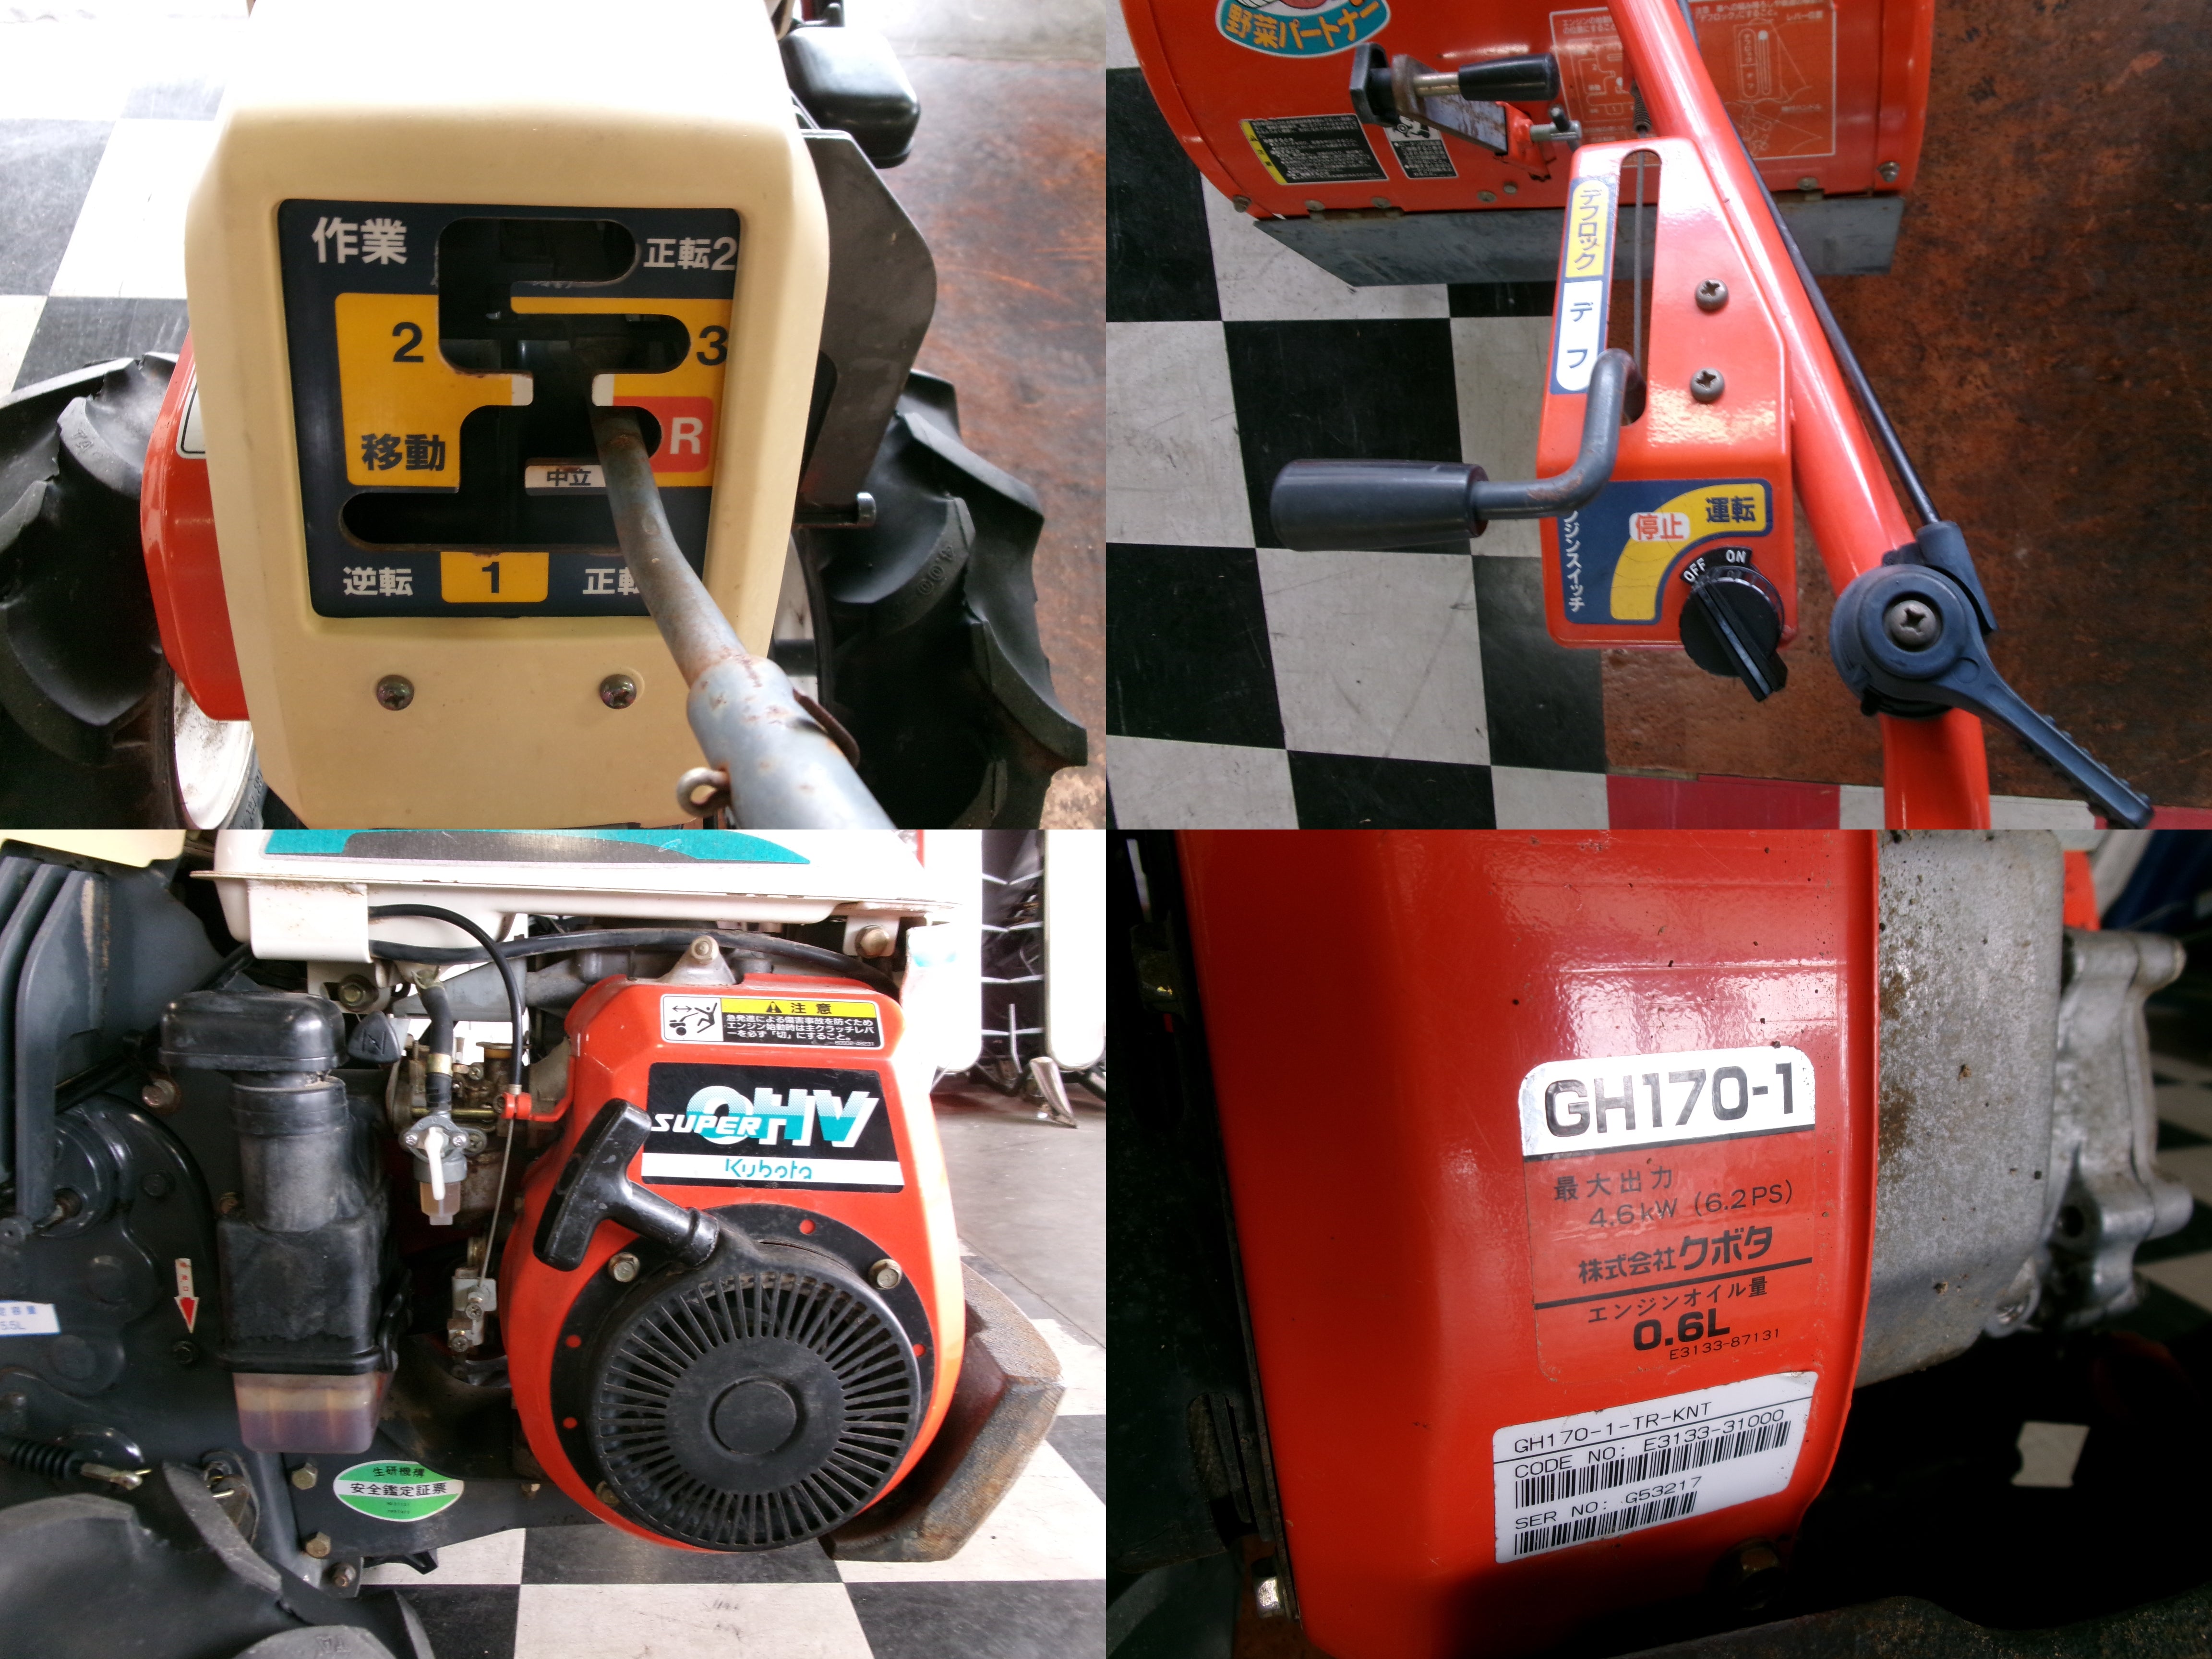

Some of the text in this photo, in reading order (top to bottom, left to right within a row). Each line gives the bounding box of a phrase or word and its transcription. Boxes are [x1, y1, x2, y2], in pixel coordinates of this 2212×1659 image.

[1225, 1, 1380, 49] 野菜パートナー
[312, 216, 408, 265] 作業
[1573, 188, 1602, 271] デフロック
[643, 236, 737, 272] 正転2
[391, 321, 424, 363] 2
[696, 325, 728, 366] 3
[1566, 301, 1593, 369] デフ
[361, 433, 446, 472] 移動
[671, 417, 704, 455] R
[546, 469, 592, 488] 中立
[1634, 513, 1684, 540] 停止
[1705, 495, 1756, 523] 運転
[1683, 558, 1706, 583] OFF
[1725, 550, 1746, 564] ON
[342, 566, 414, 597] 逆転
[481, 561, 501, 594] 1
[726, 1014, 874, 1026] 急発進による傷害事故を防ぐため
[790, 1002, 832, 1015] 注意
[727, 1022, 875, 1034] エンジン始動時は主クラッチレバ
[651, 1085, 879, 1148] SUPER OHV
[1545, 1061, 1793, 1138] GH170-1
[725, 1157, 813, 1179] Kubota
[1554, 1166, 1673, 1203] 最大出力
[1589, 1179, 1793, 1228] 4.6kW (6.2PS)
[1578, 1226, 1773, 1285] 株式会社クボタ
[1588, 1275, 1768, 1324] エンジンオイル量
[1633, 1307, 1731, 1351] 0.6L
[1669, 1328, 1780, 1360] E3133-87131
[1514, 1401, 1713, 1454] GH170-1-TR-KNT
[1515, 1409, 1785, 1479] CODE NO: E3133-31000
[350, 1482, 447, 1497] 安全鑑定証票
[373, 1466, 425, 1479] 生研機構
[1515, 1476, 1703, 1530] SER NO: G53217
